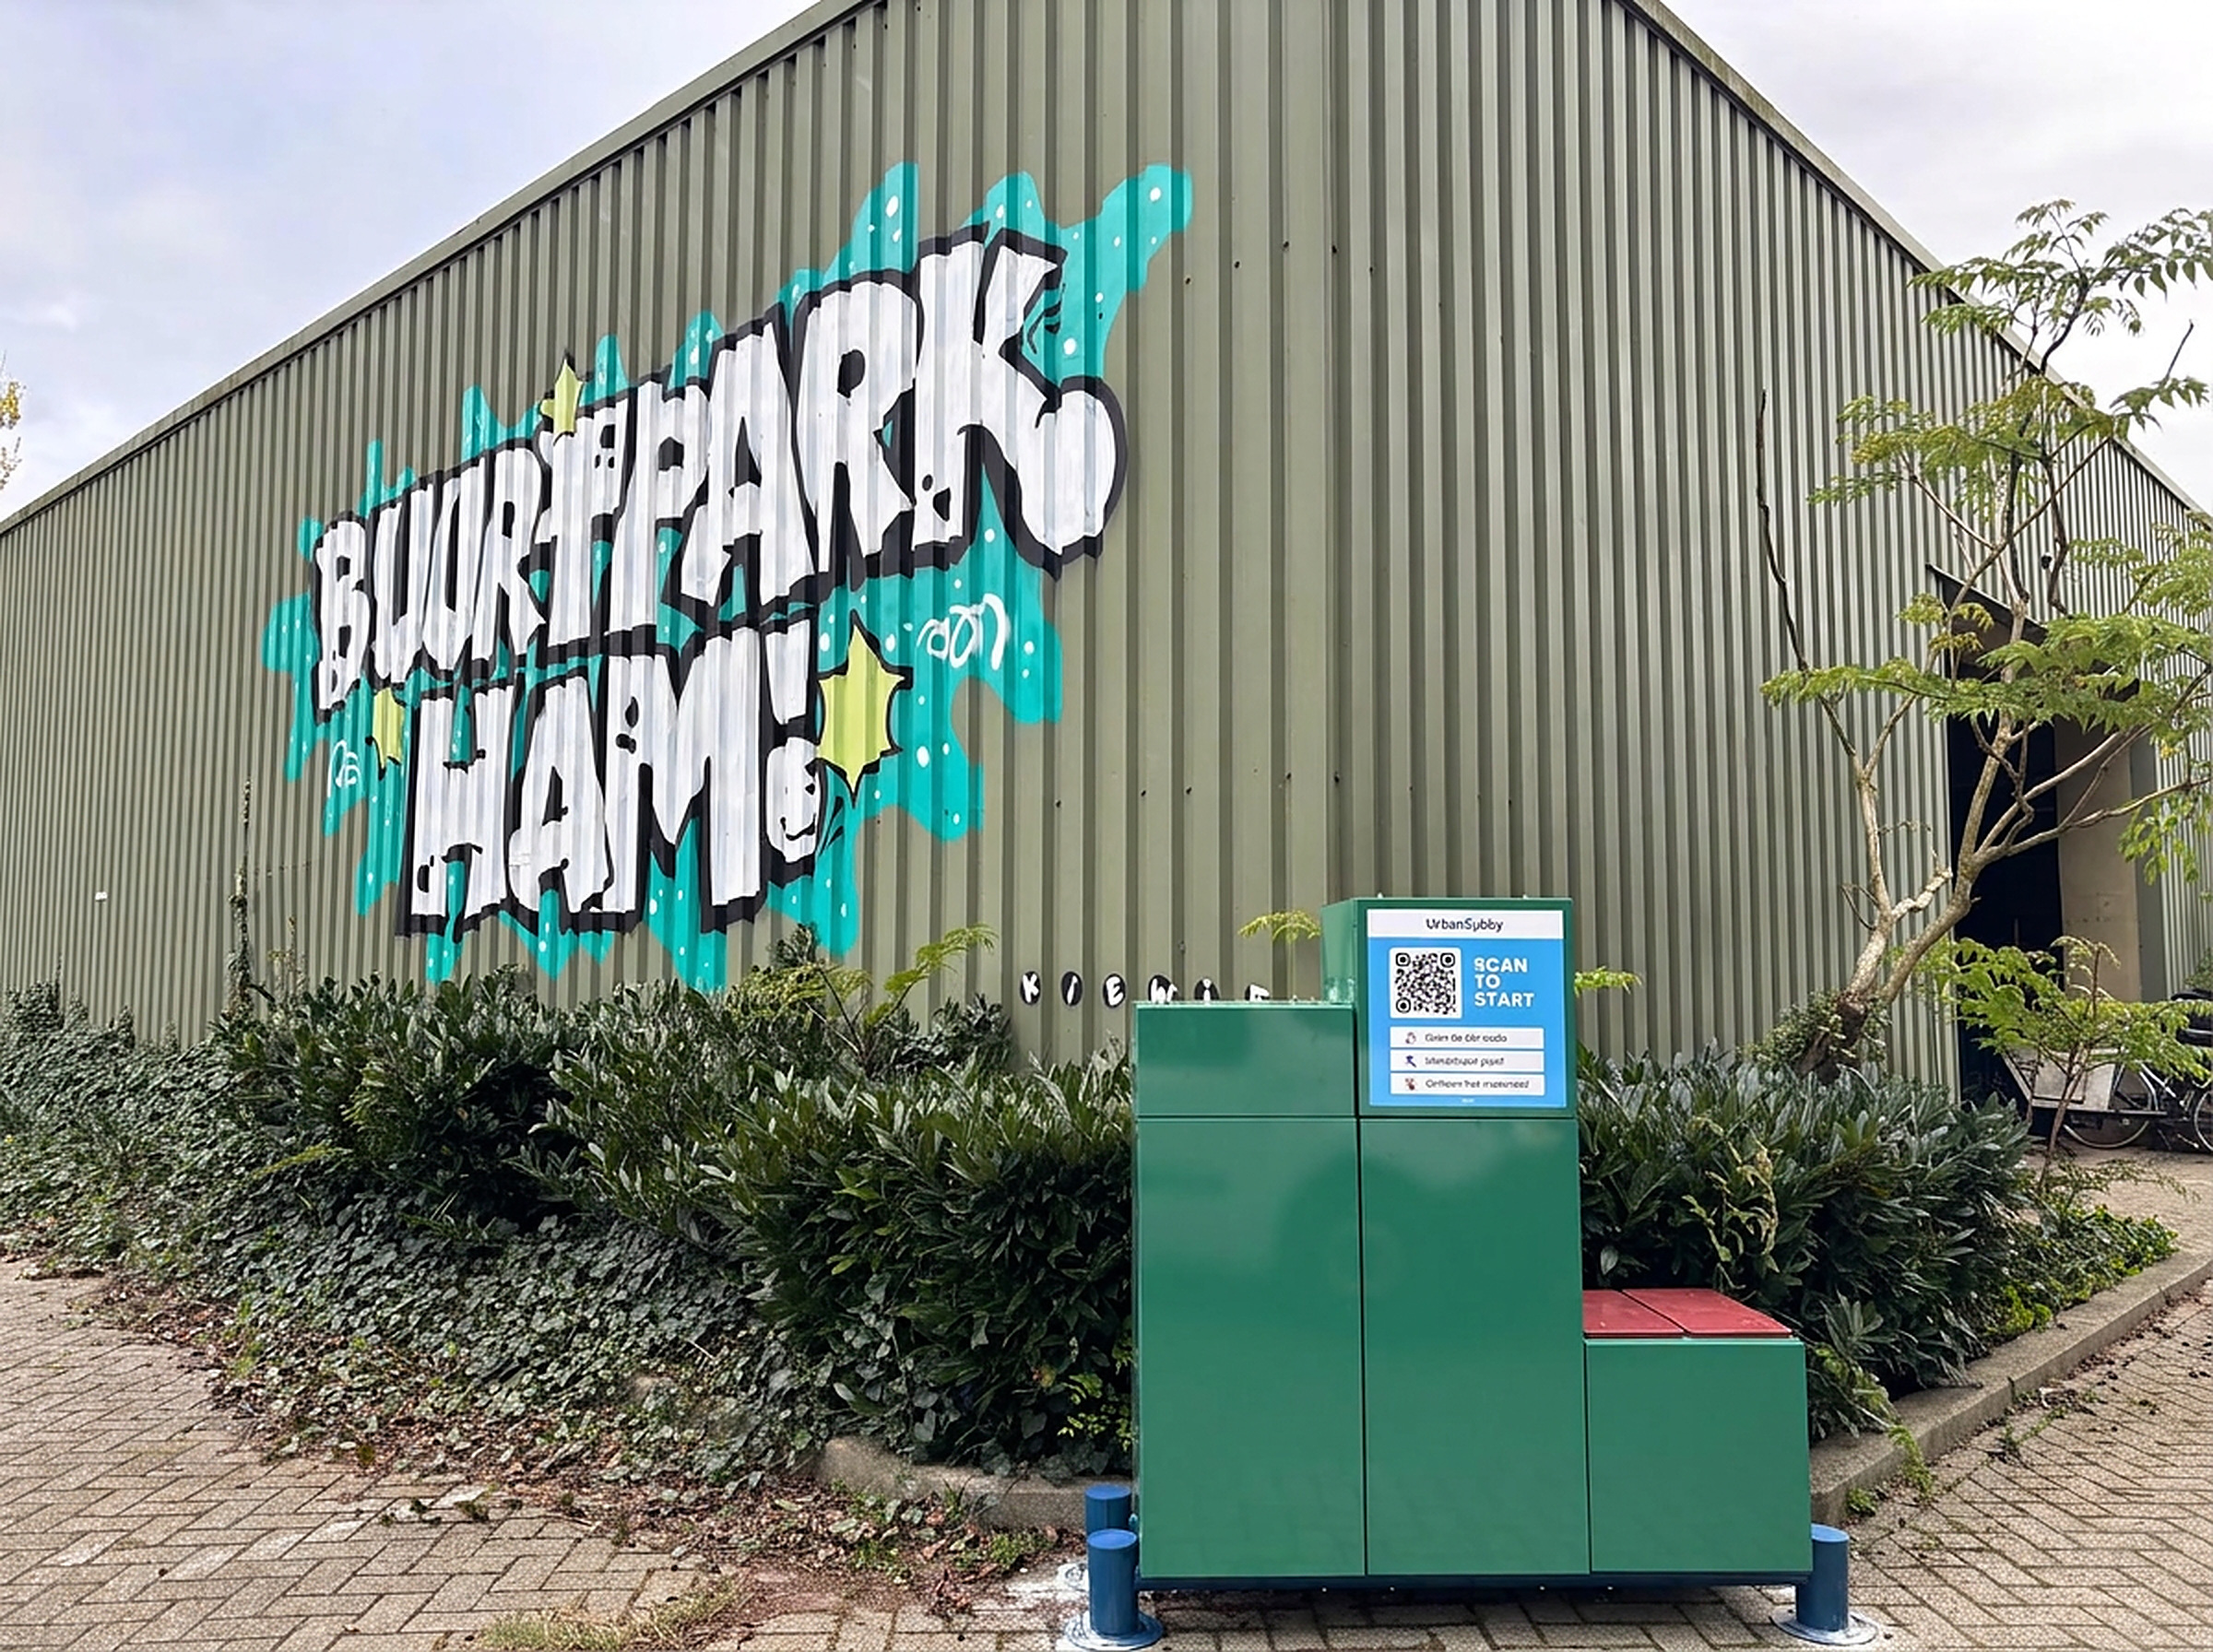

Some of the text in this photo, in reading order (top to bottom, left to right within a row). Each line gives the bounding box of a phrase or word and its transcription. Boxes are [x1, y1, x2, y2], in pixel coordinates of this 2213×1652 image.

[396, 613, 822, 937] HAM!
[1473, 957, 1528, 973] SCAN
[1474, 974, 1501, 989] TO
[1474, 992, 1534, 1008] START
